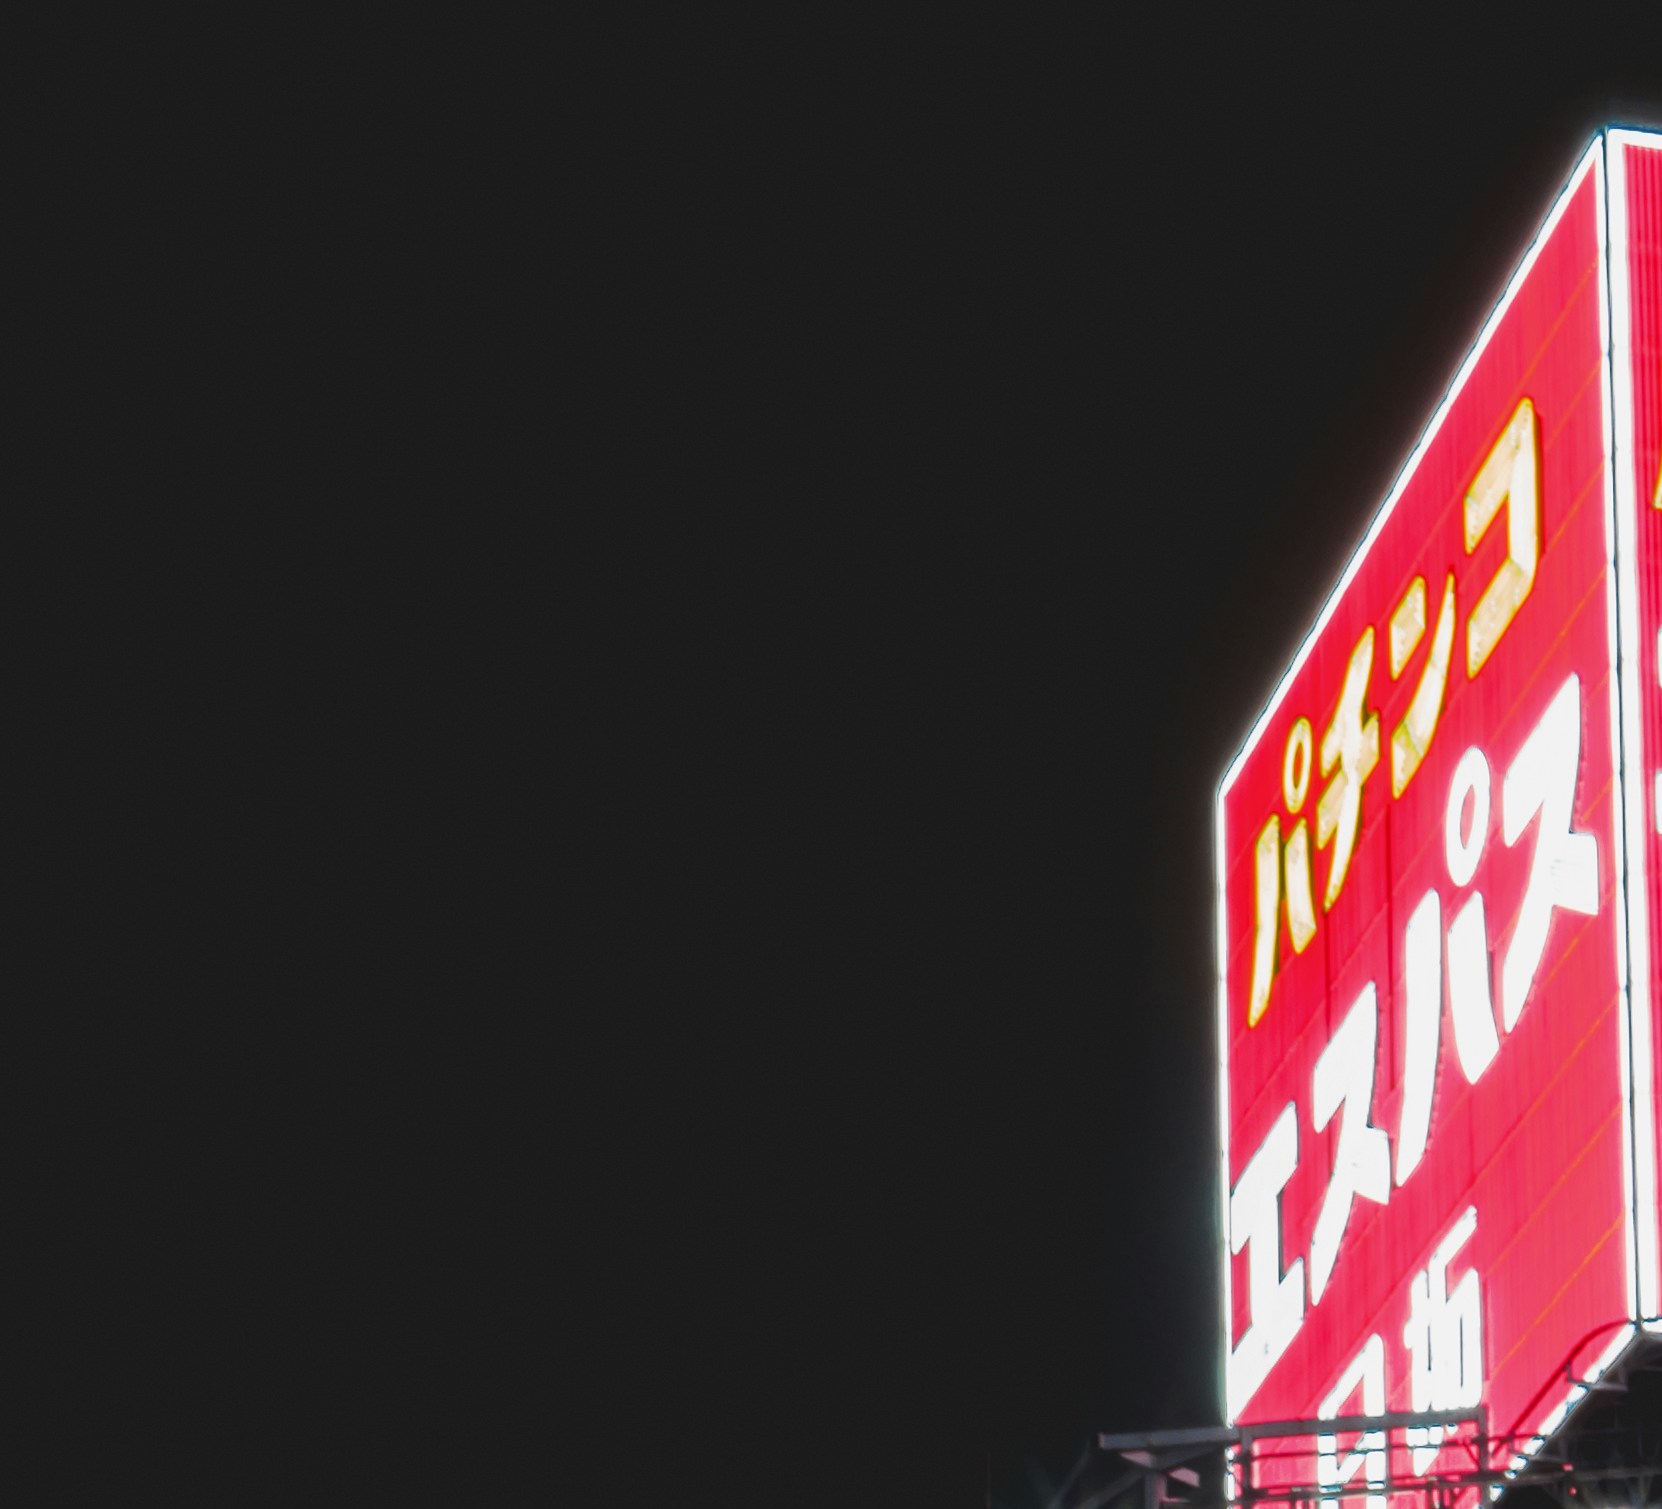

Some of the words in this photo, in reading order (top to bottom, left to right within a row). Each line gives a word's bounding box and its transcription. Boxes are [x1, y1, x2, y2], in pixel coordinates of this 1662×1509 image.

[1226, 672, 1598, 1428] エスパス
[1246, 396, 1540, 1028] パチンコ
